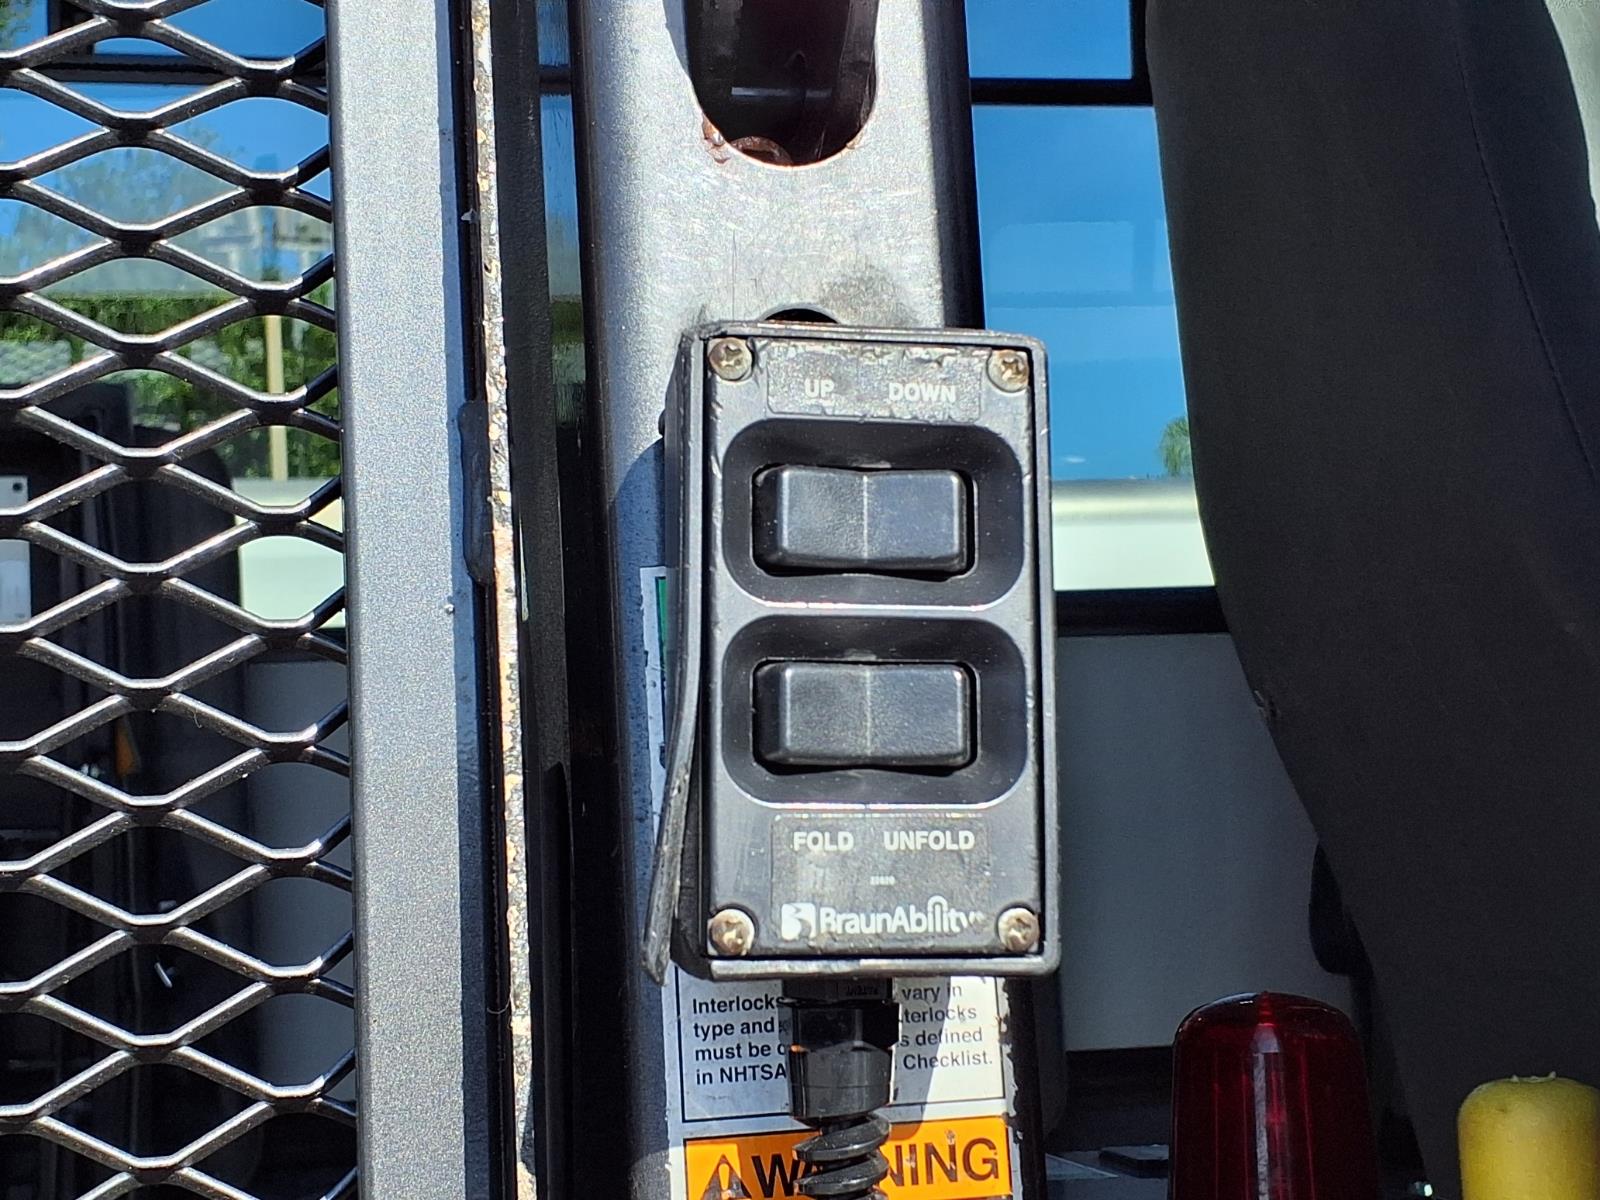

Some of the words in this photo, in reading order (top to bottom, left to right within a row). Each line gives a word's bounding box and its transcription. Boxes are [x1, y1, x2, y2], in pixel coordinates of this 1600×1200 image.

[804, 377, 835, 399] UP
[888, 381, 957, 402] DOWN
[793, 831, 855, 851] FOLD
[883, 830, 976, 851] UNFOLD
[692, 993, 785, 1015] Interlocks
[901, 986, 940, 1004] vary
[946, 982, 963, 998] in
[693, 1022, 735, 1042] type
[740, 1016, 775, 1035] and
[898, 1004, 977, 1025] terlocks
[695, 1042, 742, 1061] must
[748, 1041, 771, 1058] be
[896, 1034, 911, 1048] s
[915, 1026, 983, 1047] defined
[696, 1068, 713, 1085] in
[719, 1062, 788, 1084] NHTSA
[902, 1048, 993, 1071] Checklist.
[751, 1136, 999, 1198] WNING
